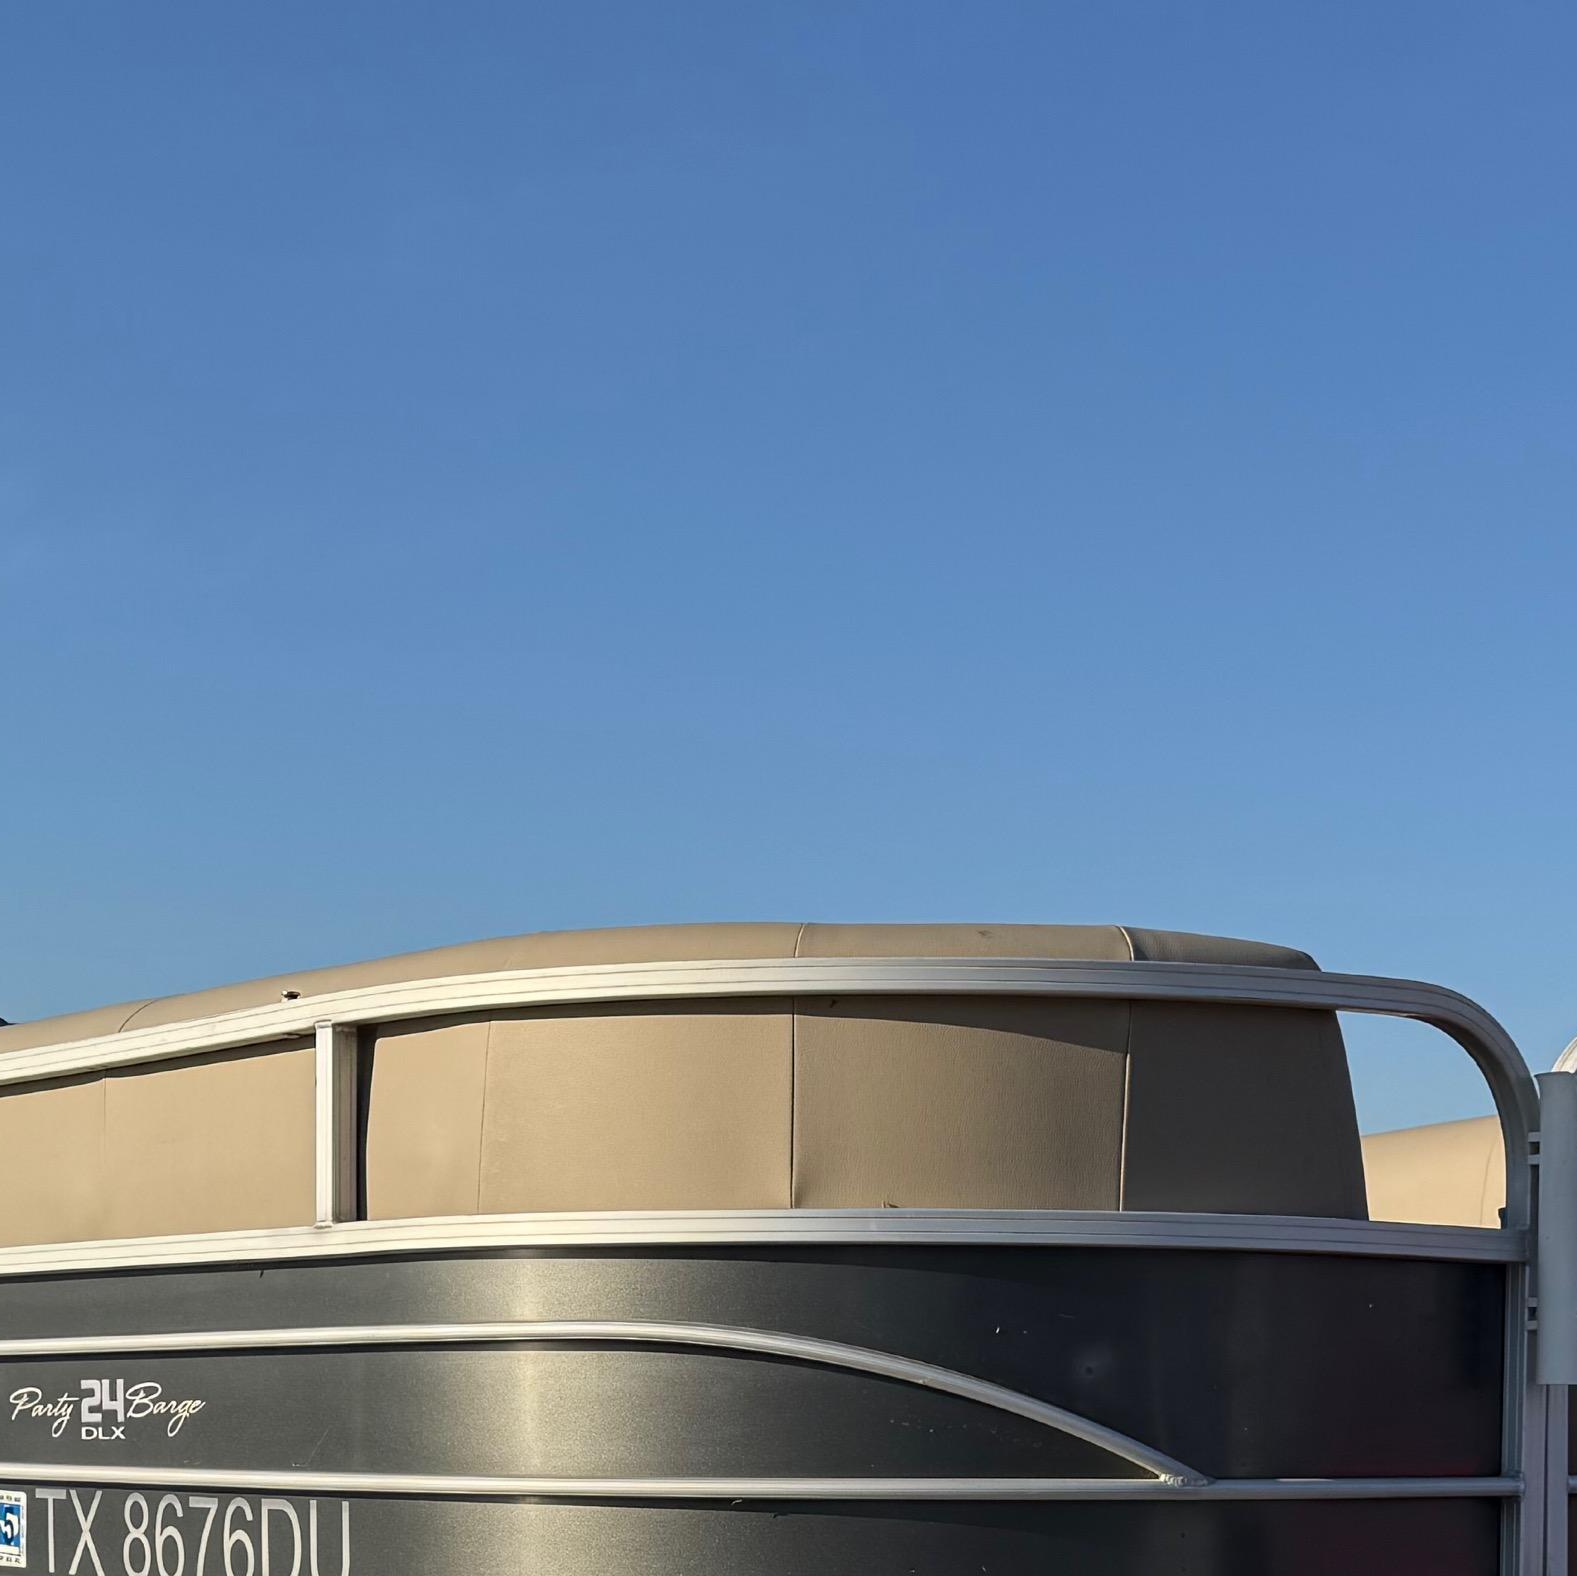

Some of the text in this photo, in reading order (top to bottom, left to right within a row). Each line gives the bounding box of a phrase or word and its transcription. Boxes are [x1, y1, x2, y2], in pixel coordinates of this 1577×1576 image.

[9, 1379, 206, 1438] Party 24 Barge
[80, 1425, 126, 1441] DLX
